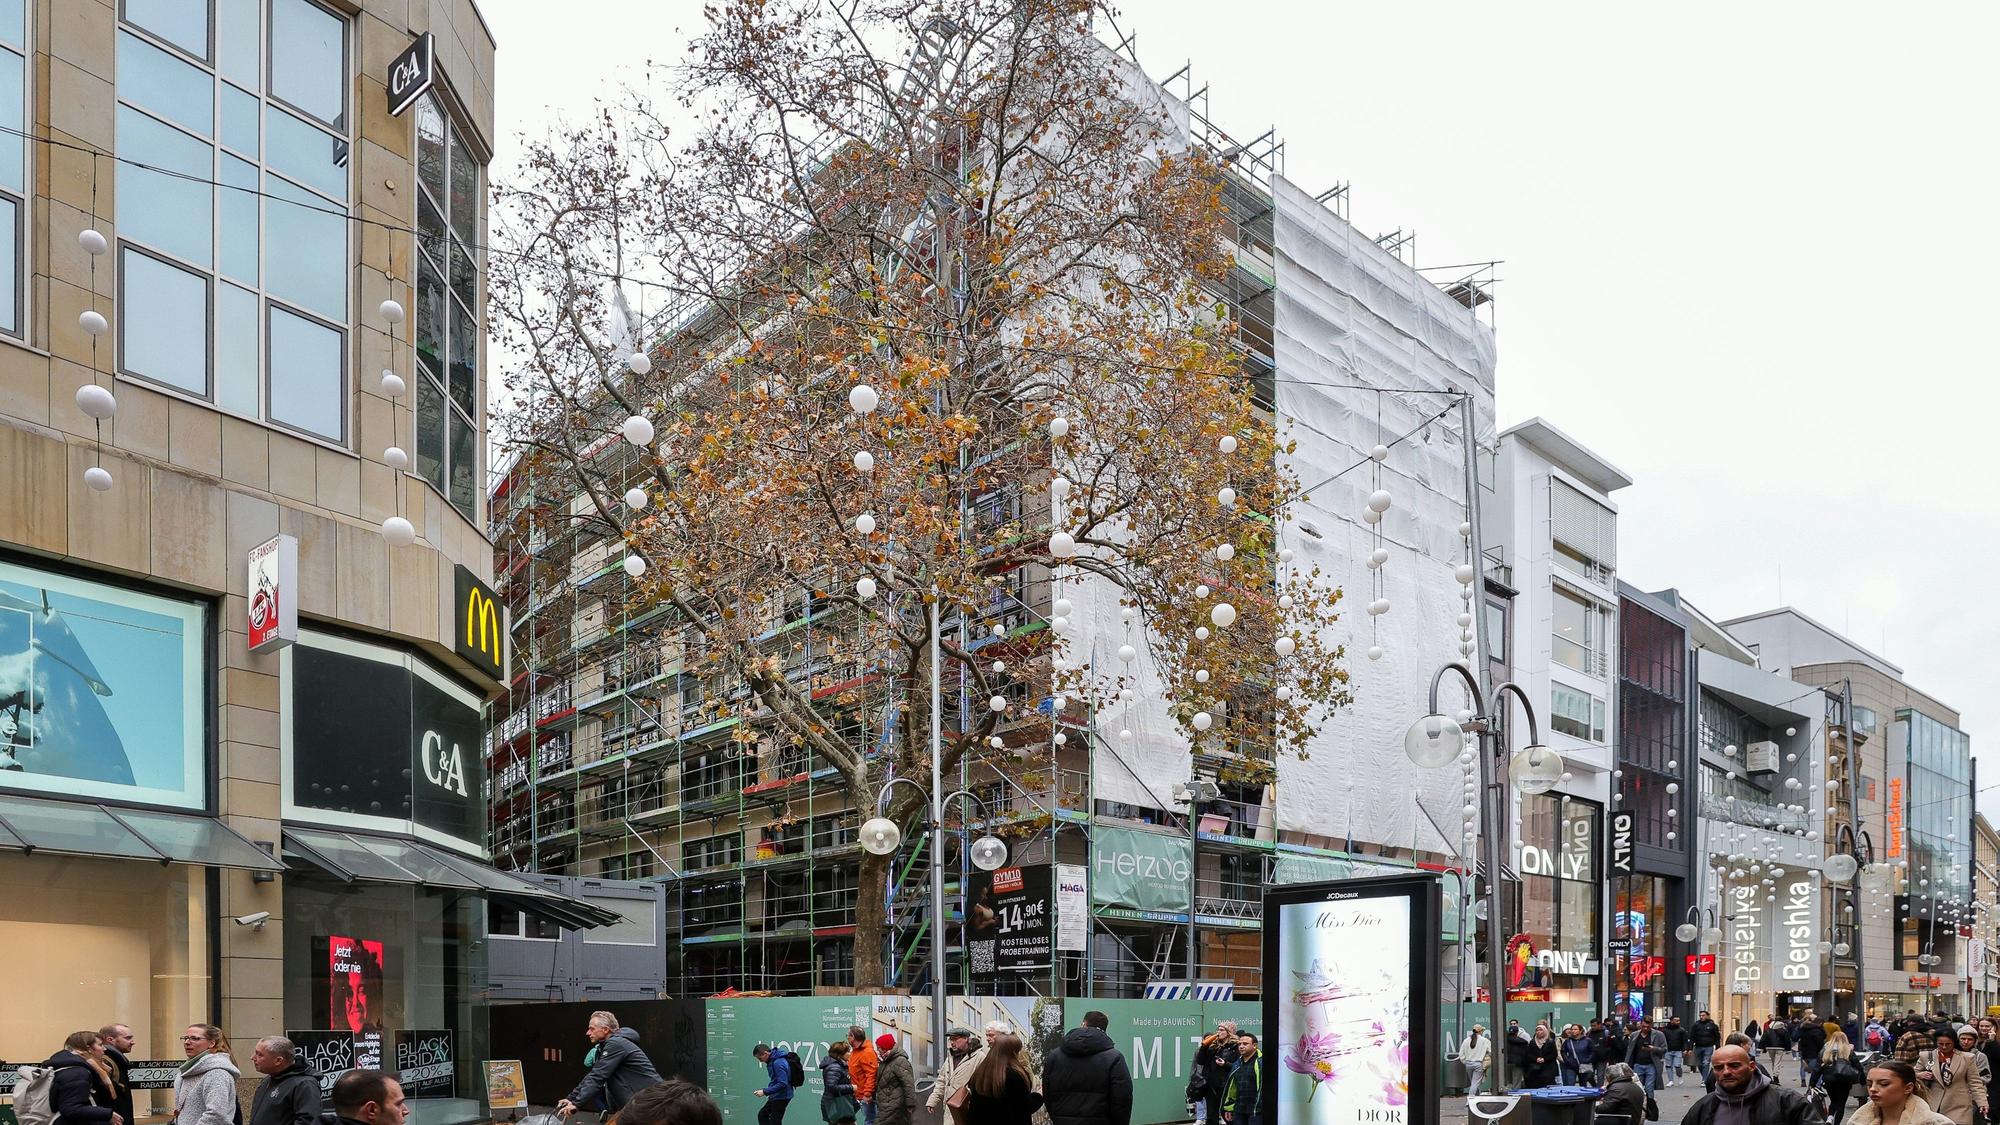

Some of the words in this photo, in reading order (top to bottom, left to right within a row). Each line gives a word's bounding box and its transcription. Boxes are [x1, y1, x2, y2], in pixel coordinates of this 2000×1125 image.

[392, 51, 421, 95] C&A
[249, 538, 278, 564] FC-FANSHOP
[421, 730, 468, 798] C&A
[1614, 814, 1631, 872] ONLY
[1522, 845, 1583, 880] ONLY
[993, 869, 1021, 883] GYM10
[1060, 883, 1085, 893] HAGA
[1326, 892, 1359, 900] JCDecaux
[1109, 909, 1179, 922] HEINEN-GRUPPE
[1350, 910, 1382, 927] Dior
[1782, 881, 1811, 980] Bershka
[1001, 936, 1049, 946] KOSTENLOSES
[334, 944, 352, 958] Jetzt
[1000, 946, 1049, 956] PROBETRAINING
[334, 959, 351, 973] oder
[351, 961, 361, 973] nie
[1538, 949, 1589, 975] ONLY
[878, 1005, 916, 1013] BAUWENS
[1133, 1017, 1152, 1026] Made
[1153, 1017, 1161, 1027] by
[1163, 1017, 1196, 1026] BAUWENS
[295, 1037, 351, 1059] BLACK
[397, 1035, 450, 1057] BLACK
[308, 1051, 352, 1073] RIDAY
[398, 1048, 450, 1070] FRIDAY
[138, 1070, 174, 1080] -20%
[434, 1076, 451, 1085] ALLES
[140, 1081, 168, 1089] RABATT
[1358, 1108, 1402, 1123] DIOR
